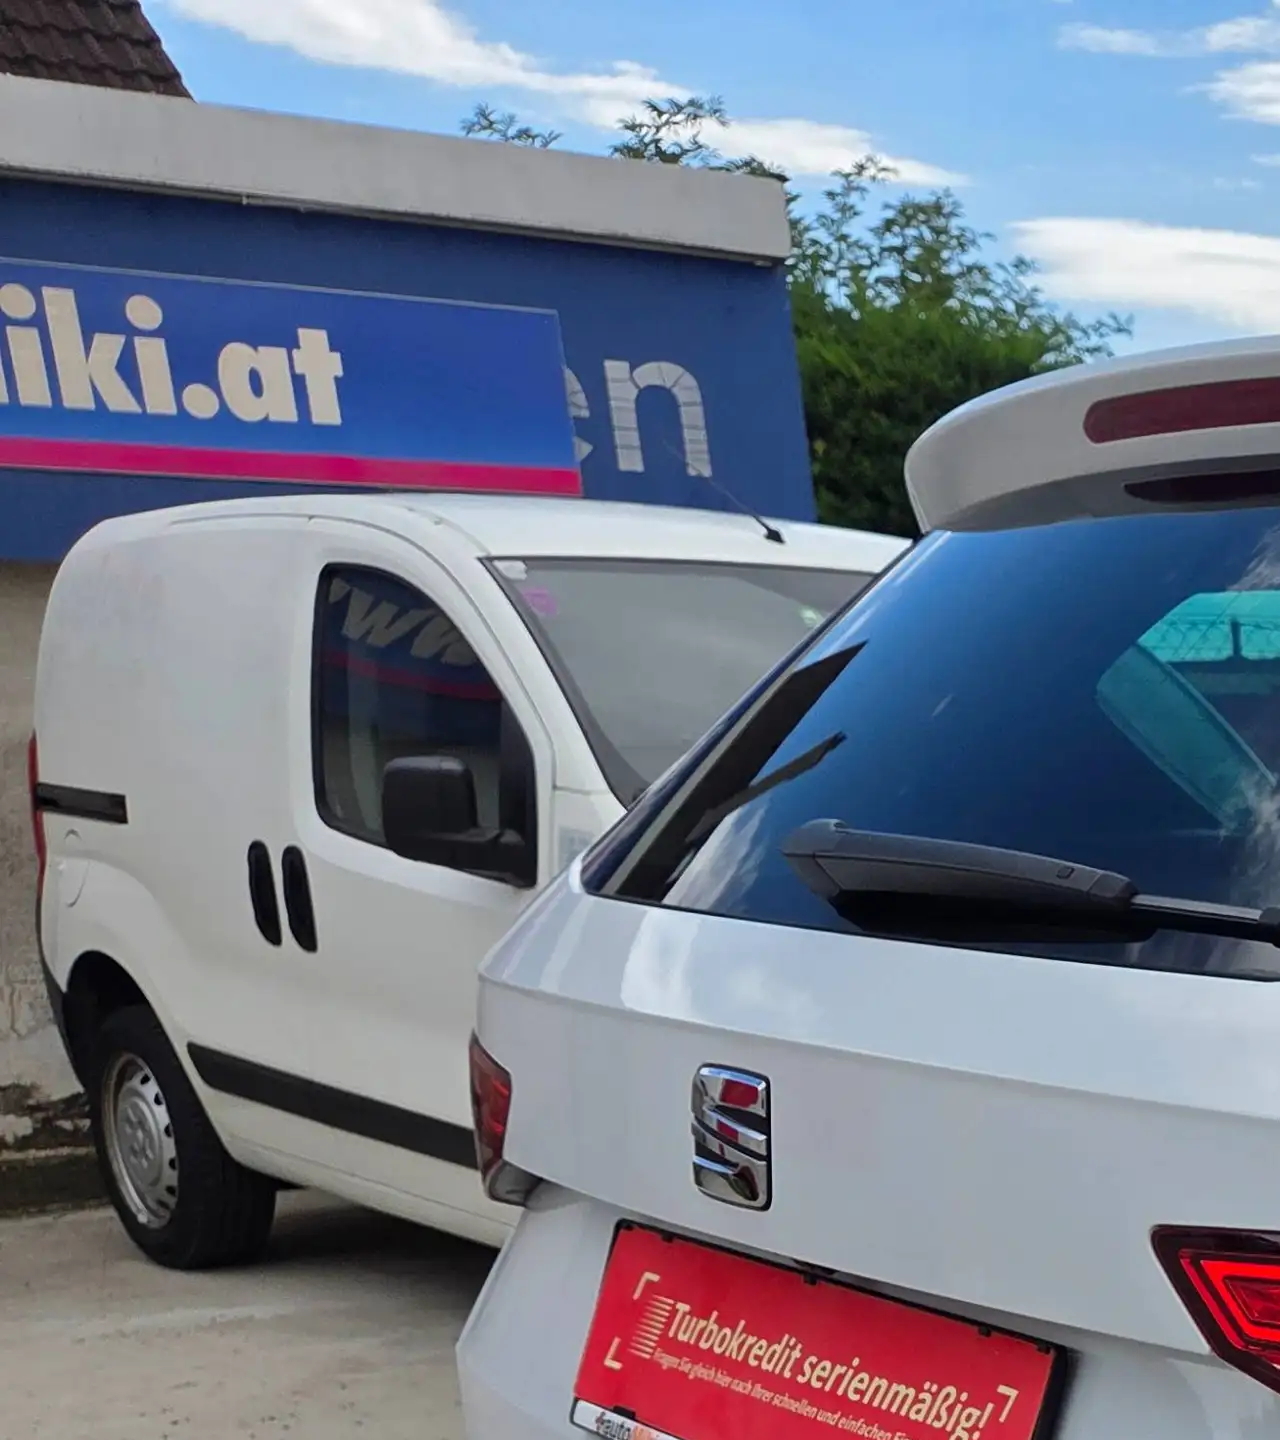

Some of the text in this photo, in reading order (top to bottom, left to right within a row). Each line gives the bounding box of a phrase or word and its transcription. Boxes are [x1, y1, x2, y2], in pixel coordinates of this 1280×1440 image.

[0, 283, 344, 426] iki.at
[668, 1302, 804, 1379] Turbokredit
[772, 1393, 817, 1419] schnellen
[816, 1410, 841, 1426] und
